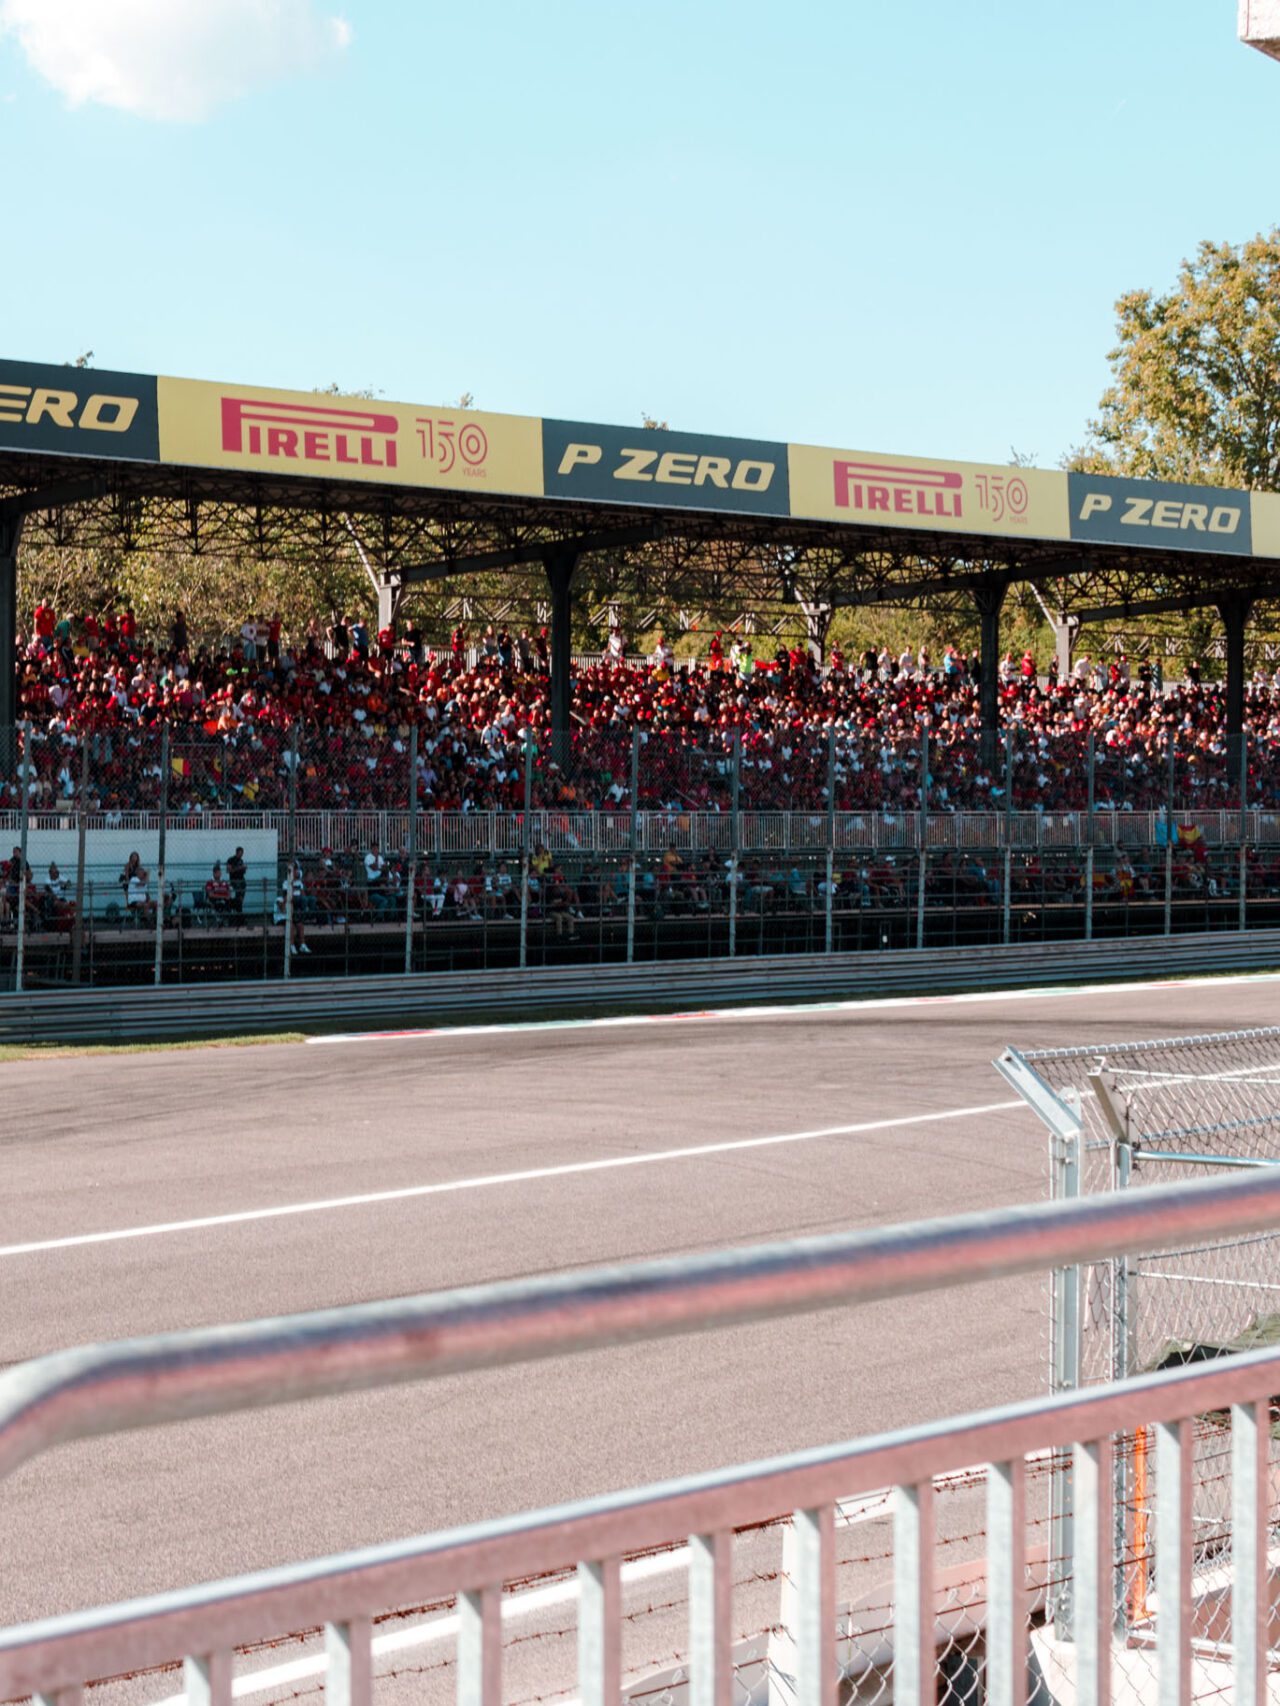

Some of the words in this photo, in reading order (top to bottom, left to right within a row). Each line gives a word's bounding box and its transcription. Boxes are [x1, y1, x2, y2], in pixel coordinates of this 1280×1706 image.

[220, 396, 399, 468] PIRELLI
[415, 417, 487, 473] 150
[557, 443, 603, 475] P
[613, 448, 776, 492] ZERO
[832, 460, 963, 518] PIRELLI
[975, 474, 1028, 522] 150
[1079, 493, 1113, 521] P
[1119, 497, 1241, 534] ZERO
